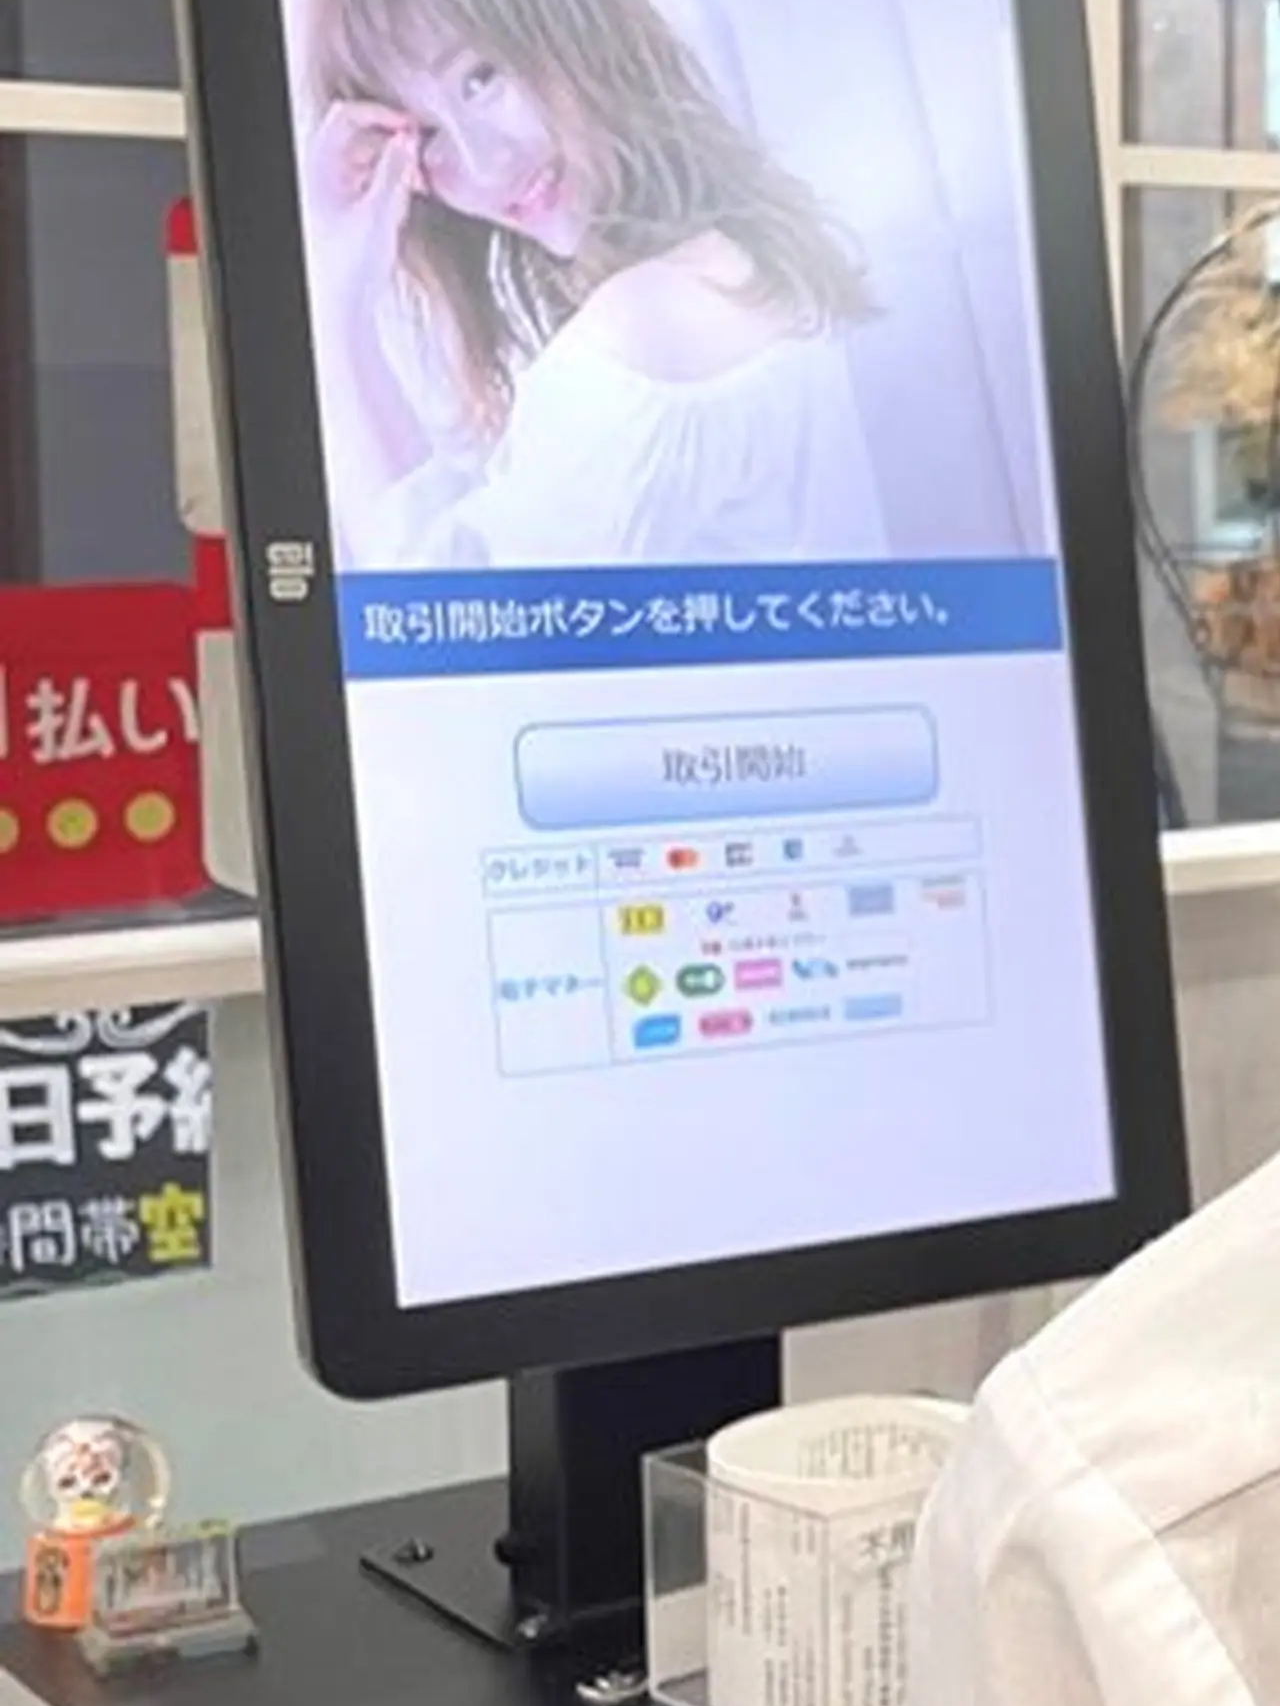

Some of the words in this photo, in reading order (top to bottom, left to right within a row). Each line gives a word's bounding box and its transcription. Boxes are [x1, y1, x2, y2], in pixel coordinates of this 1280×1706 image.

[363, 591, 950, 644] 取引開始ボタンを押してください。
[0, 663, 200, 763] 払い
[662, 744, 807, 784] 取引開始
